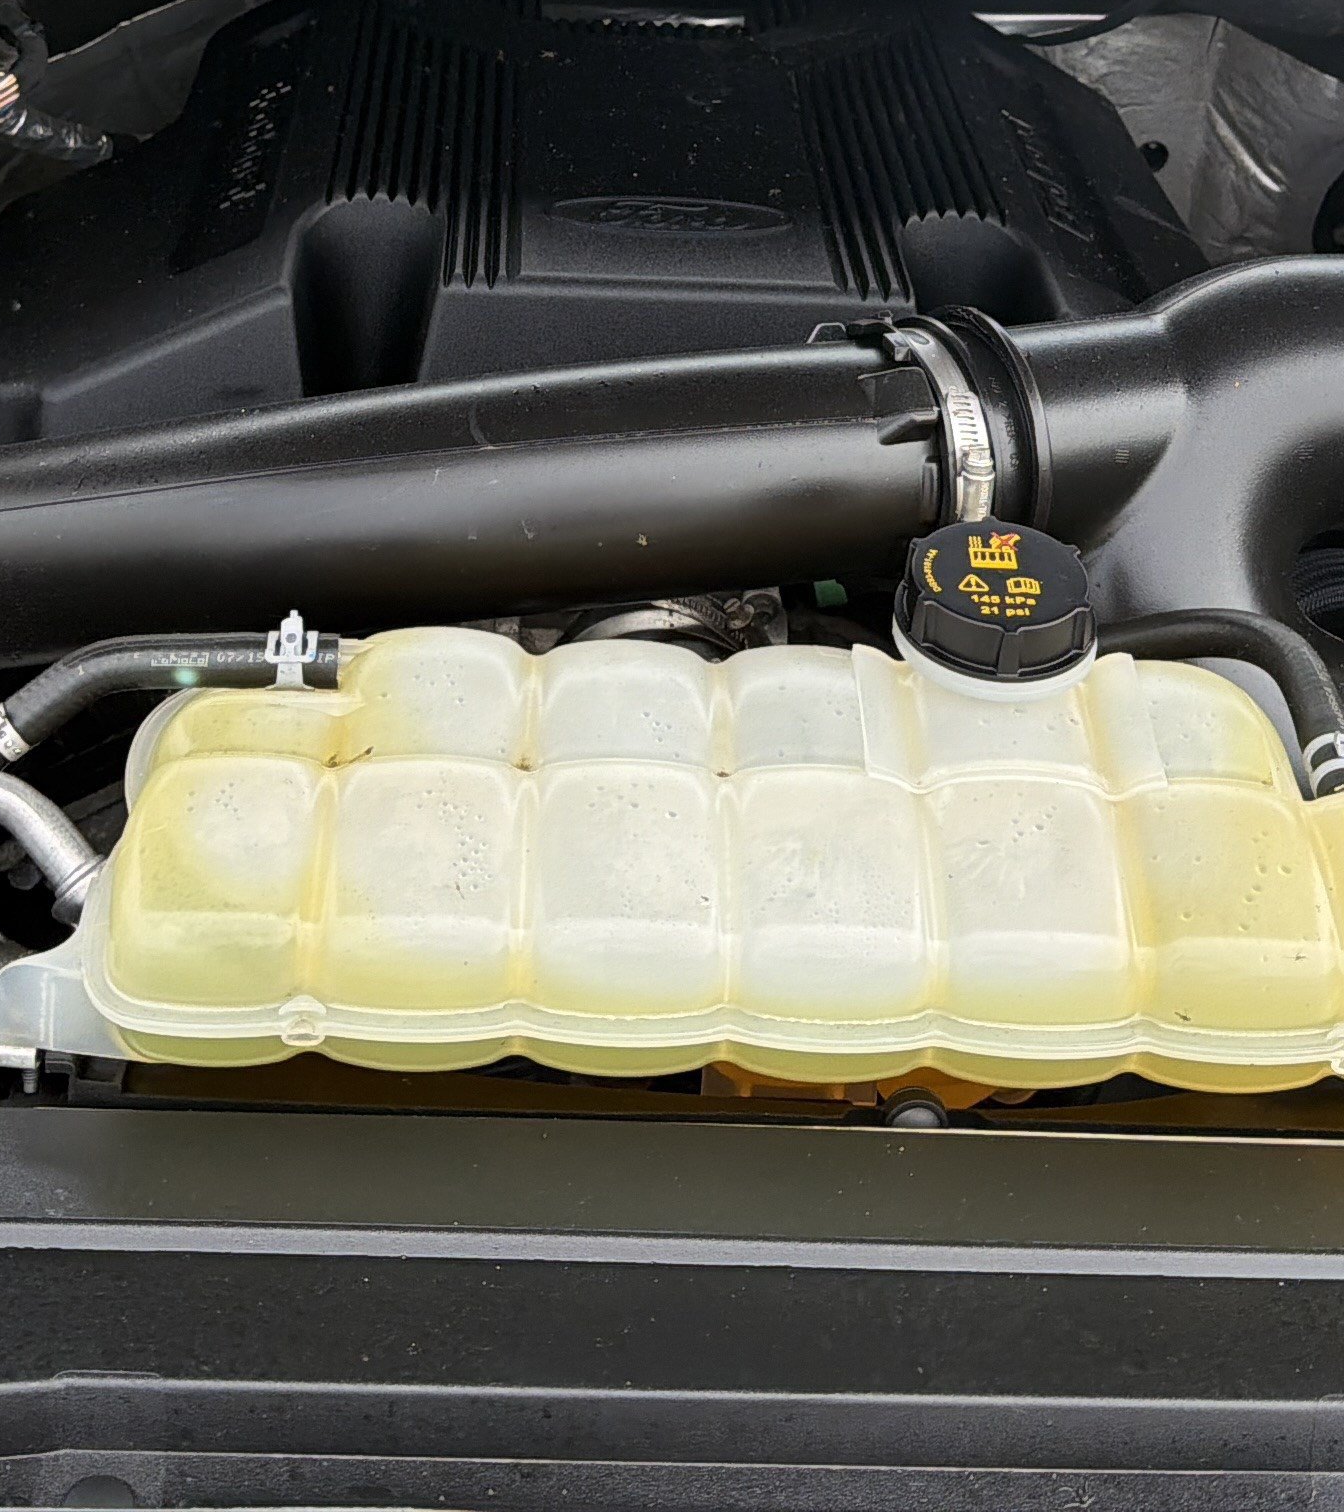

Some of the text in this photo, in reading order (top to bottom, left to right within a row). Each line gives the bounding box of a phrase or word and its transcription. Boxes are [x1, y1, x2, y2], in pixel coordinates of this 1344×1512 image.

[971, 594, 1037, 606] 145 kPa
[980, 605, 1031, 618] 21 psi
